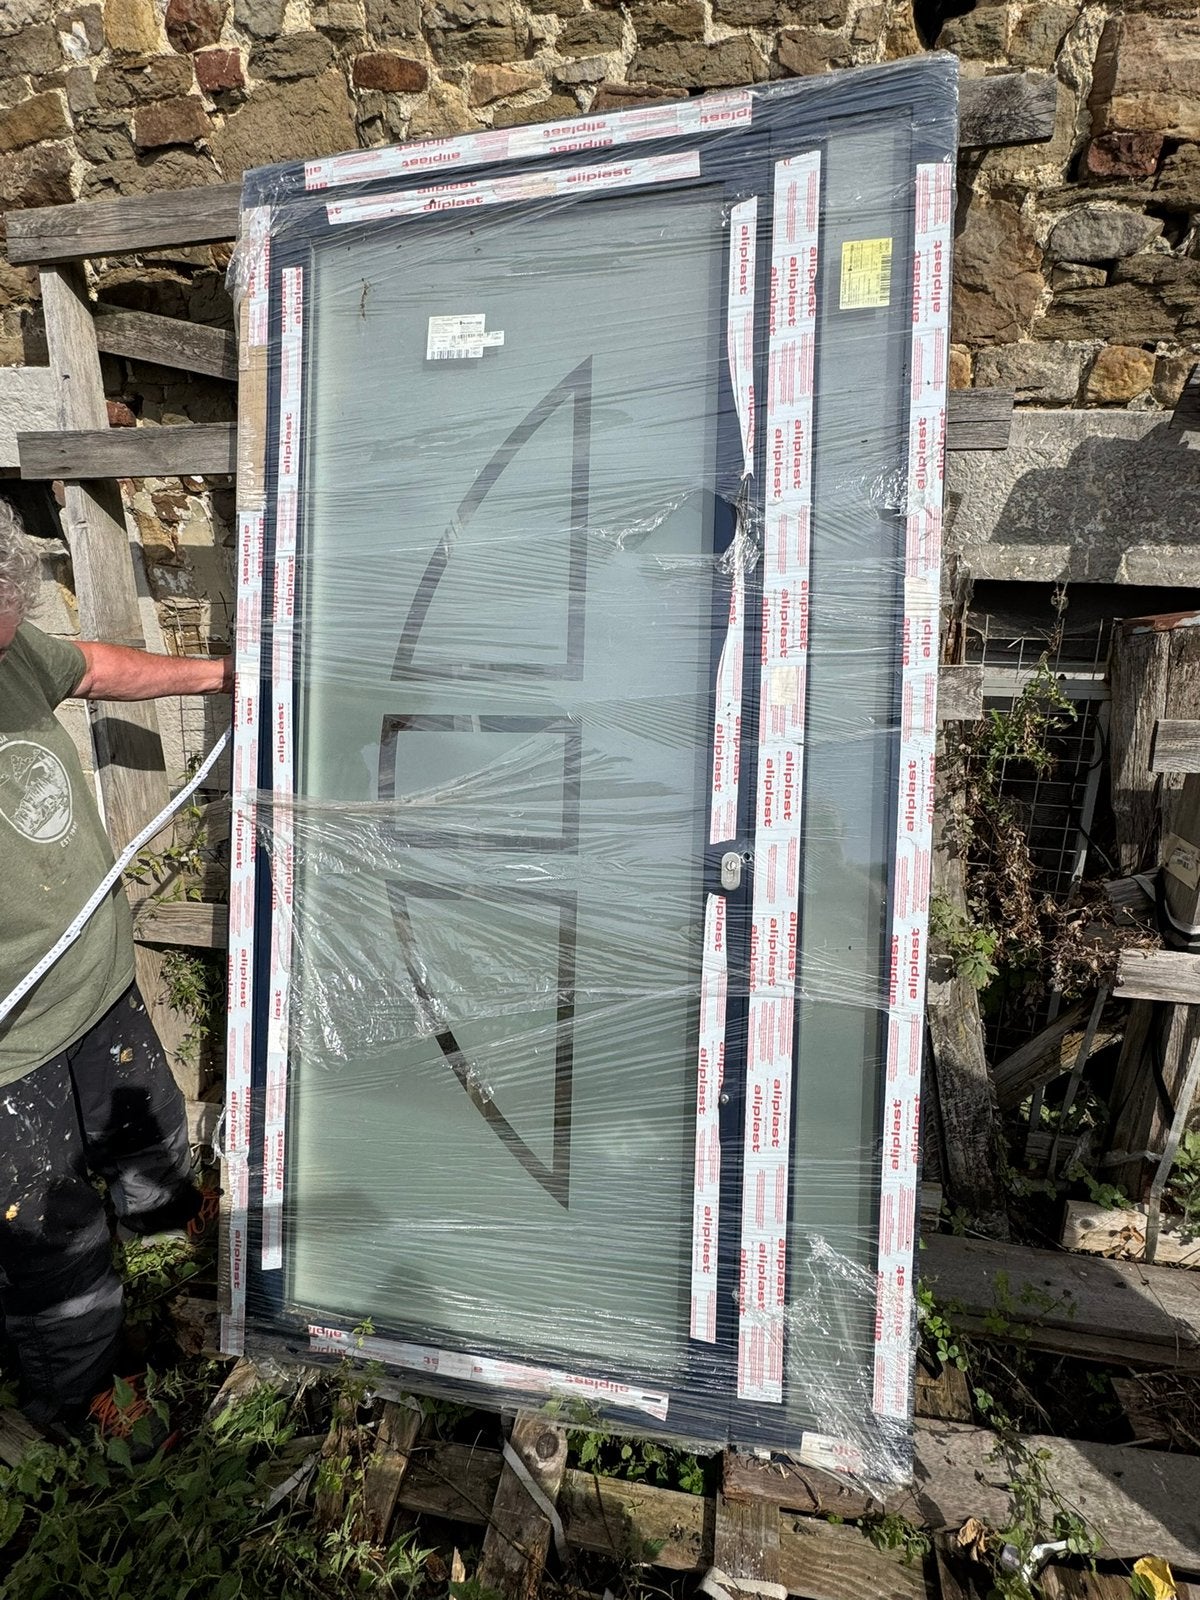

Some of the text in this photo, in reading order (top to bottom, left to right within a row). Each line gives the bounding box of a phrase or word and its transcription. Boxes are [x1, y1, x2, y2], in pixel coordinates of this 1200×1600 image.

[402, 152, 460, 168] aliplast
[544, 121, 606, 138] aliplast
[567, 167, 632, 182] aliplast
[740, 225, 750, 295] aliplast
[788, 257, 798, 326] aliplast
[808, 247, 816, 316] aliplast
[931, 240, 942, 312] aliplast
[284, 413, 292, 474] aliplast
[773, 428, 784, 498] aliplast
[793, 420, 803, 489] aliplast
[916, 416, 926, 490] aliplast
[286, 556, 294, 616] aliplast
[800, 580, 808, 650] aliplast
[780, 589, 790, 658] aliplast
[714, 724, 724, 792] aliplast
[784, 751, 794, 821] aliplast
[764, 758, 774, 828] aliplast
[906, 760, 916, 832] aliplast
[236, 810, 244, 869] aliplast
[768, 918, 778, 987] aliplast
[788, 912, 798, 981] aliplast
[908, 928, 920, 1000] aliplast
[698, 1048, 708, 1115] aliplast
[772, 1078, 782, 1148] aliplast
[230, 1091, 238, 1151] aliplast
[752, 1084, 762, 1153] aliplast
[890, 1099, 902, 1170] aliplast
[702, 1206, 712, 1274] aliplast
[776, 1238, 786, 1307] aliplast
[757, 1243, 768, 1310] aliplast
